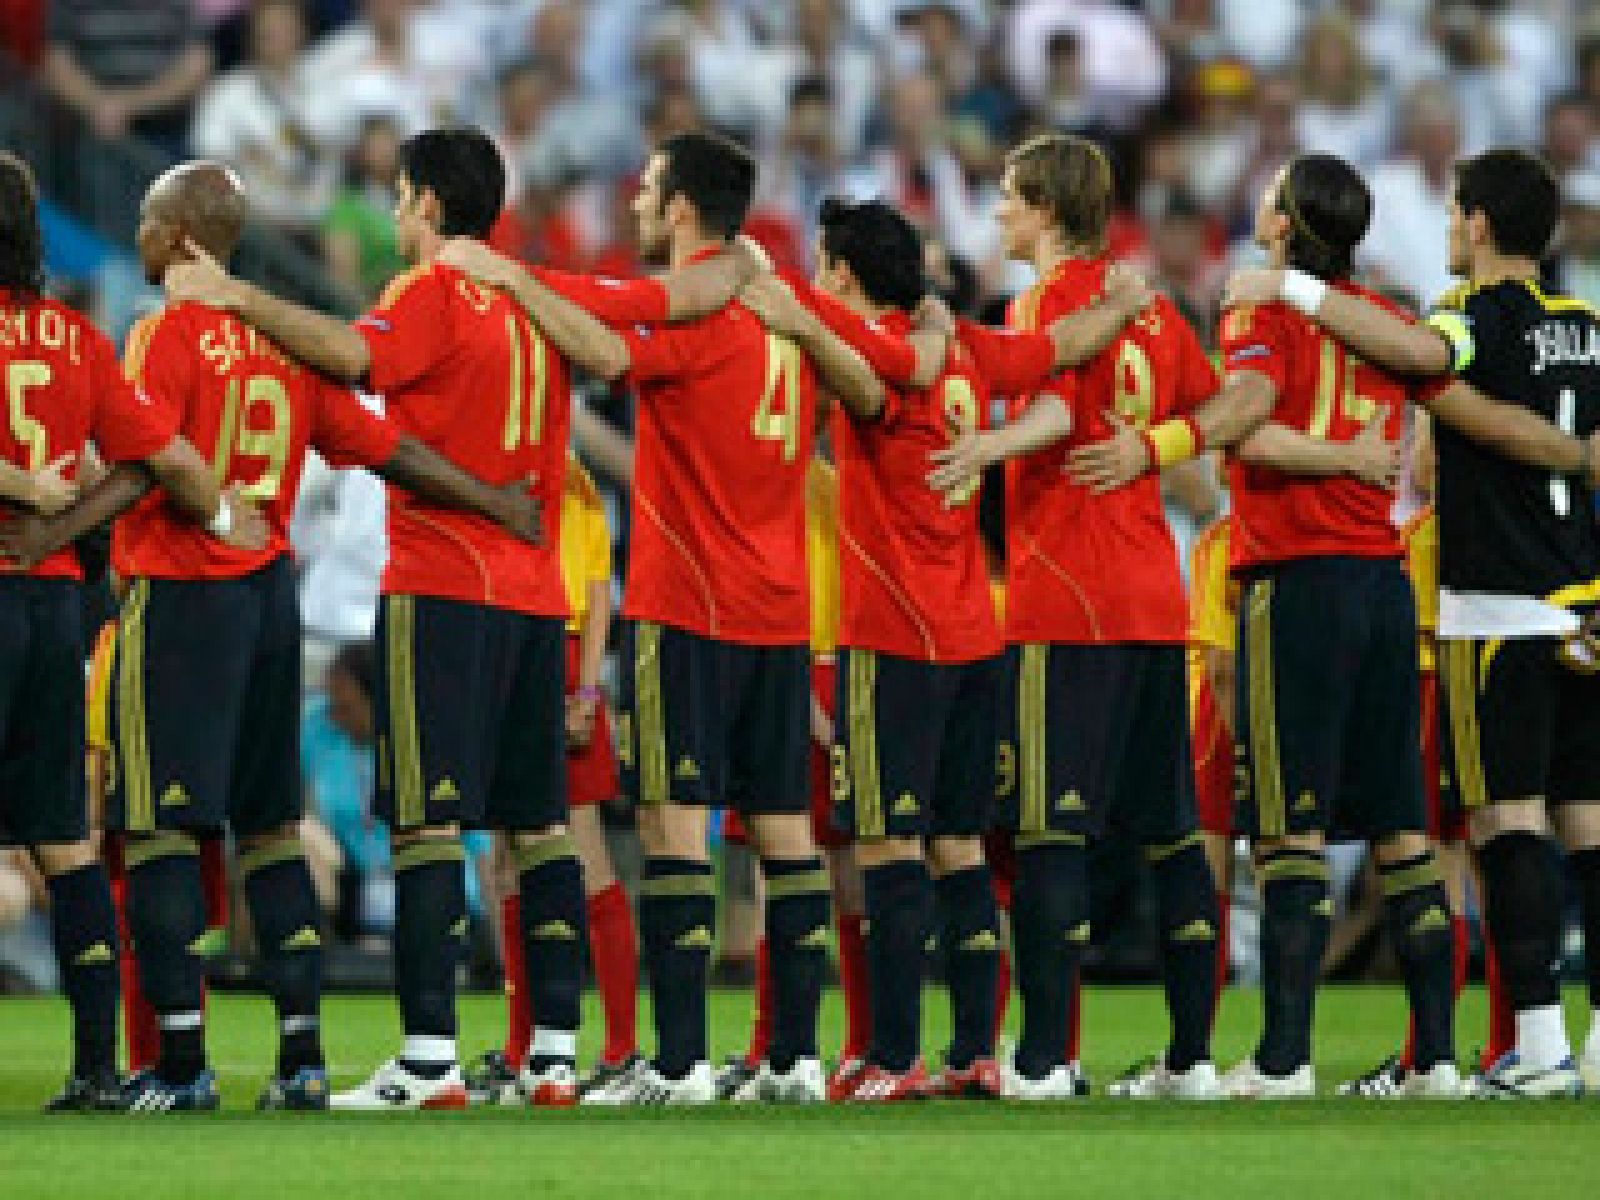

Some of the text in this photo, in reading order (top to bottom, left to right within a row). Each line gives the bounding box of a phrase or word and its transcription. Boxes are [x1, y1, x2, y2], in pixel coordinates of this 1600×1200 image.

[8, 360, 52, 472] 5
[215, 373, 291, 500] 19
[503, 313, 547, 450] 11
[750, 333, 802, 463] 4
